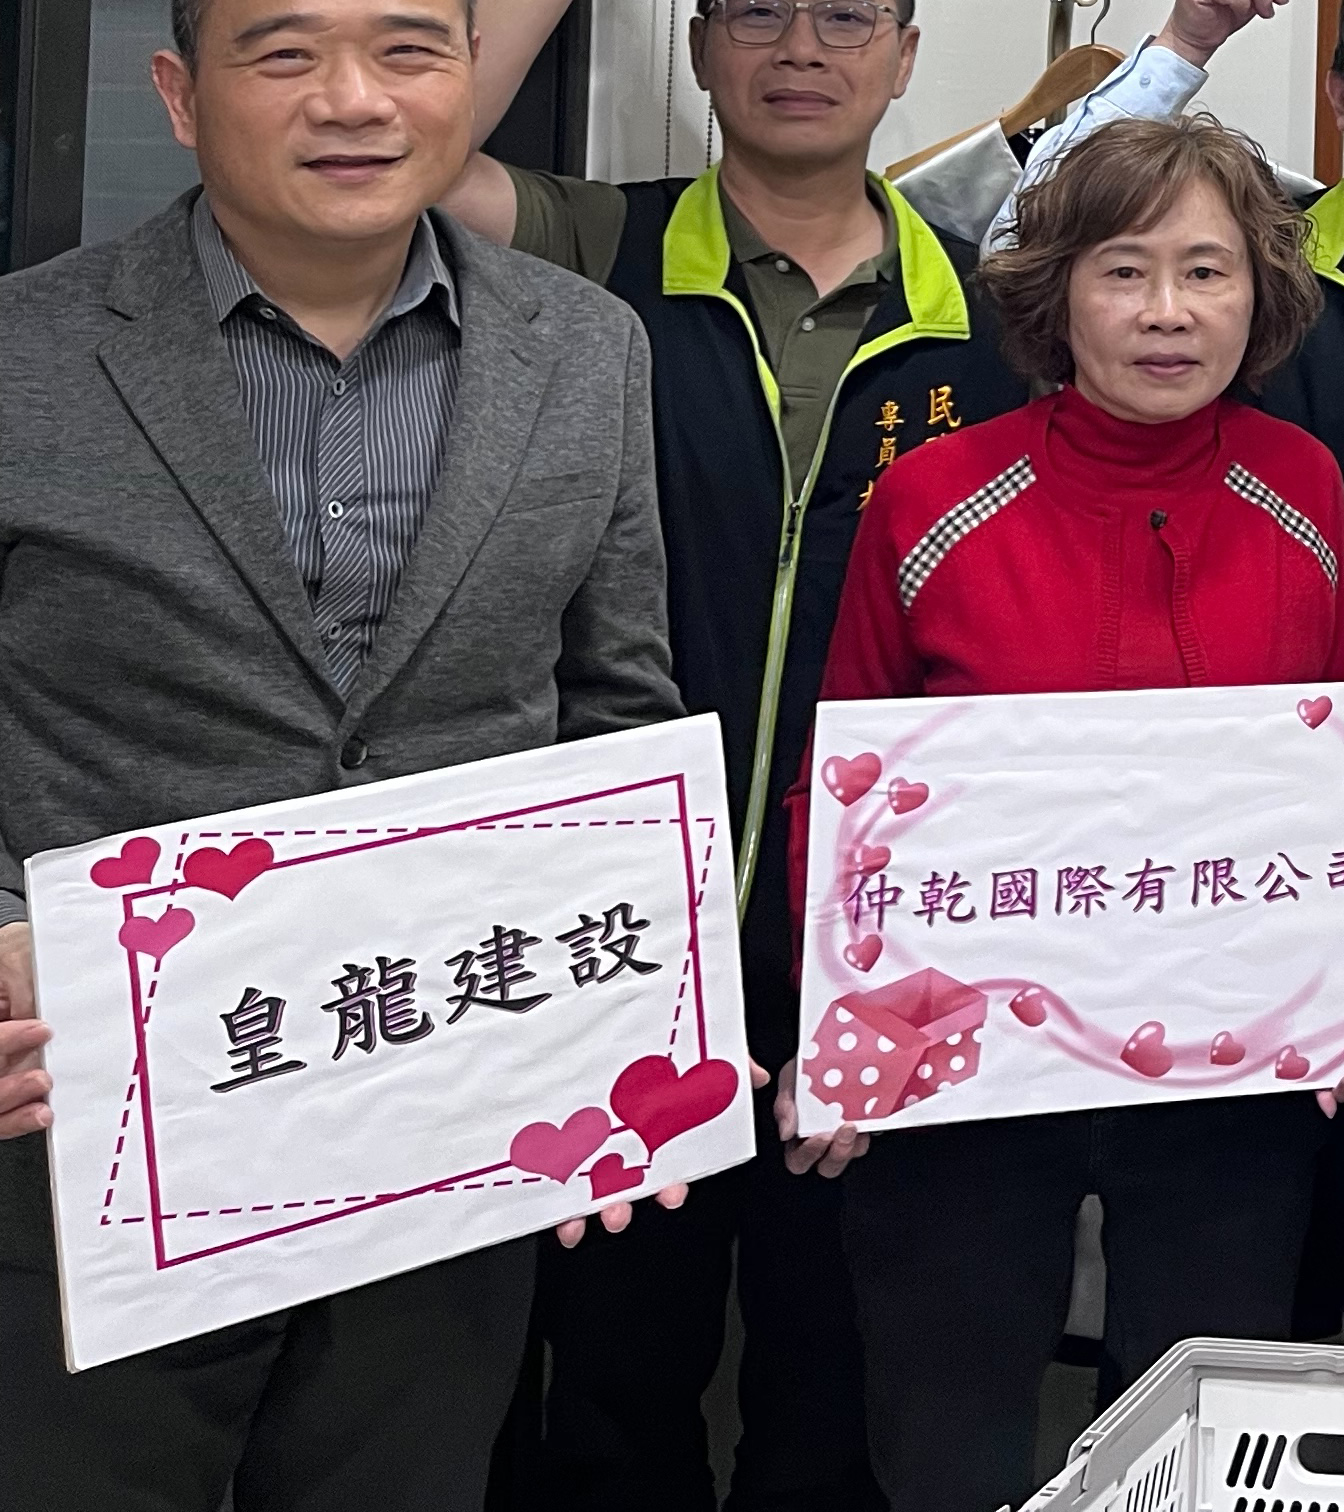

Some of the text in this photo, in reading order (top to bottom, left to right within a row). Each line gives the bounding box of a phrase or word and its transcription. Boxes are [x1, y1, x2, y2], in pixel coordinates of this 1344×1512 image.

[926, 385, 962, 443] 民
[210, 902, 663, 1094] 皇龍建設
